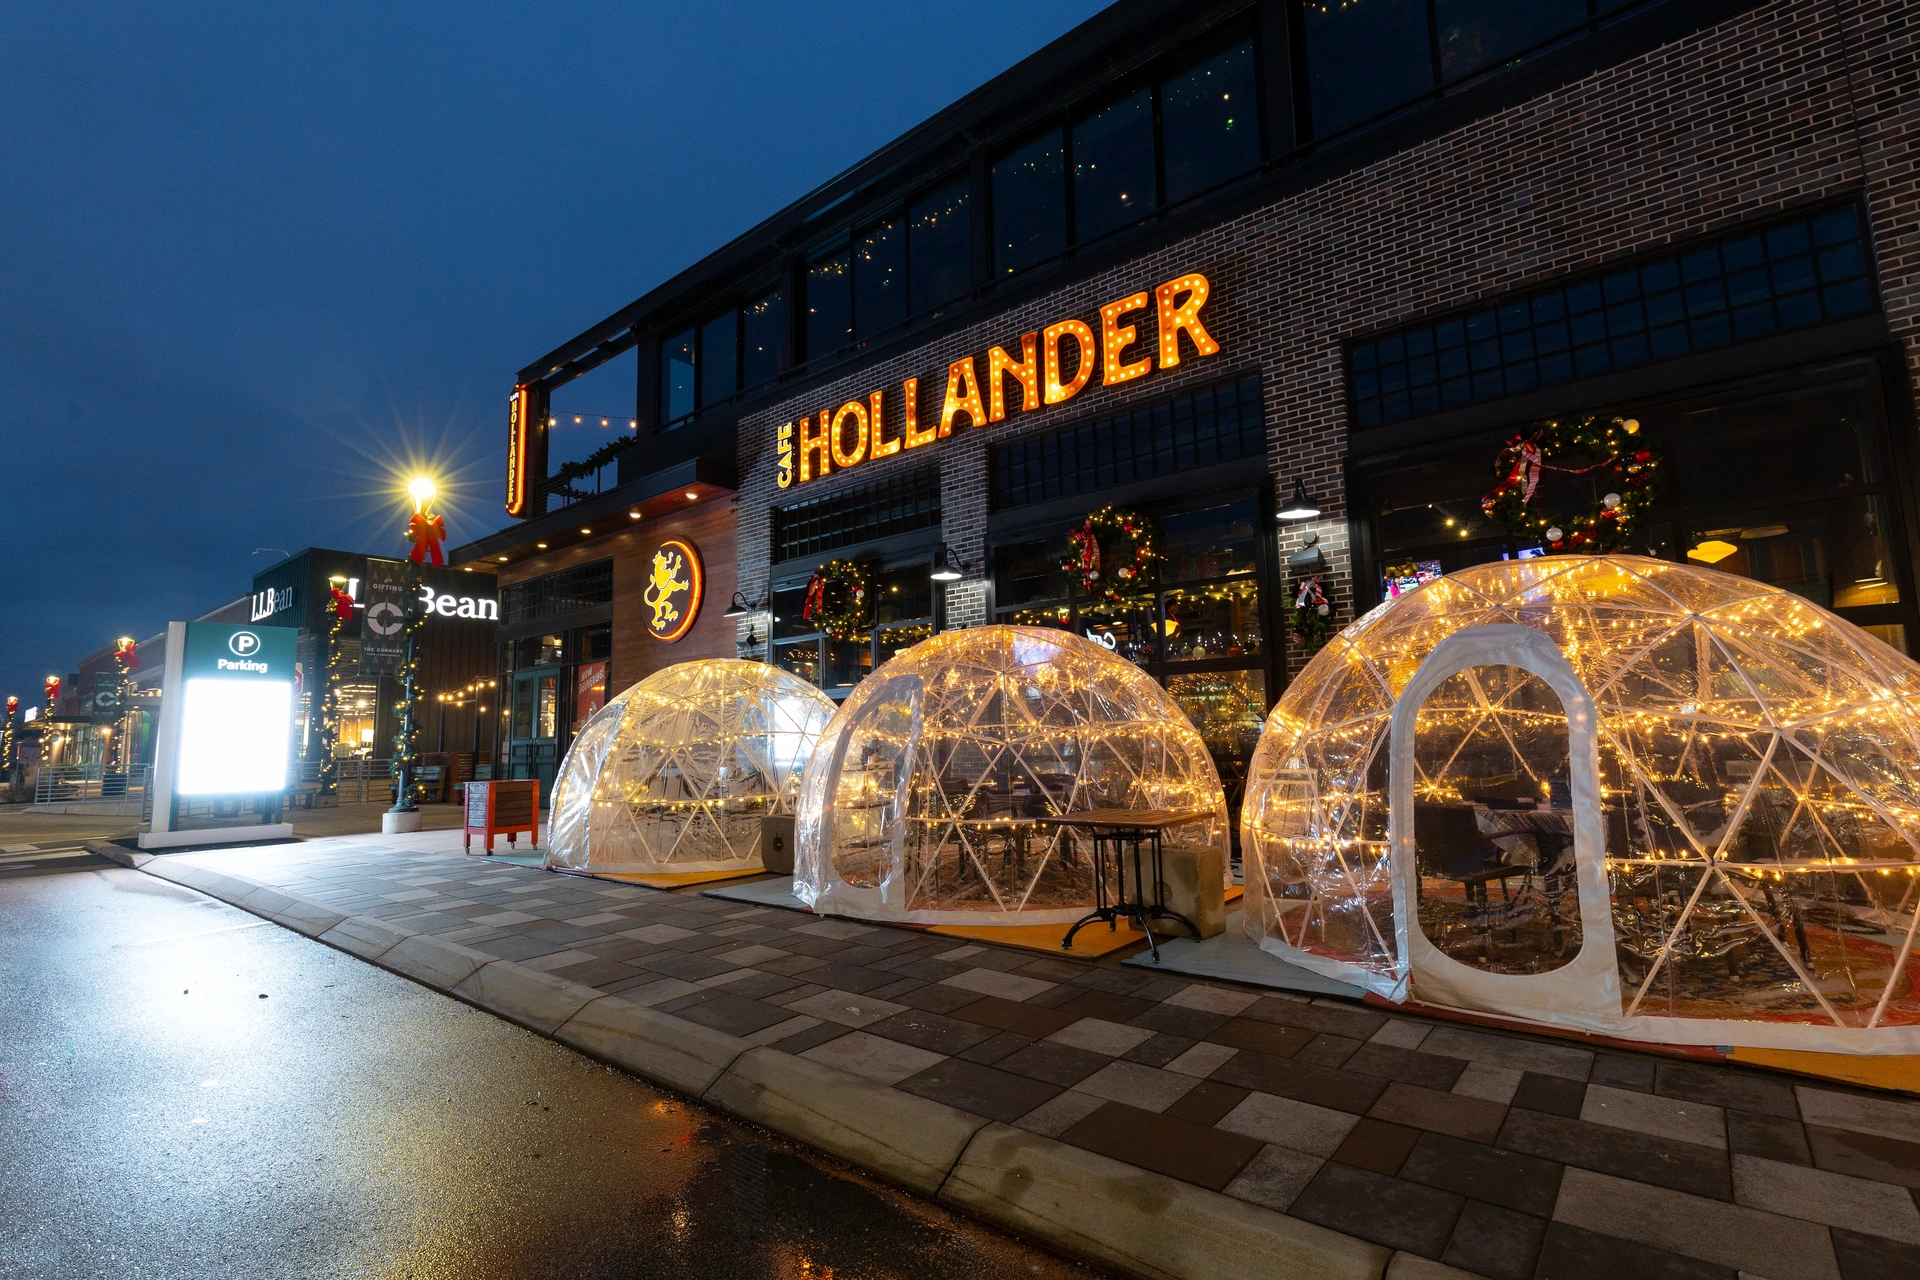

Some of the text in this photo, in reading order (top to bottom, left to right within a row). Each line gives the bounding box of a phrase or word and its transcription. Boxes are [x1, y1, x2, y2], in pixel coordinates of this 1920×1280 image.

[778, 273, 1220, 488] CAFE HOLLANDER
[509, 392, 520, 402] CAFE
[508, 400, 518, 504] HOLLANDER
[372, 583, 403, 592] GIFTING
[217, 658, 268, 674] Parking
